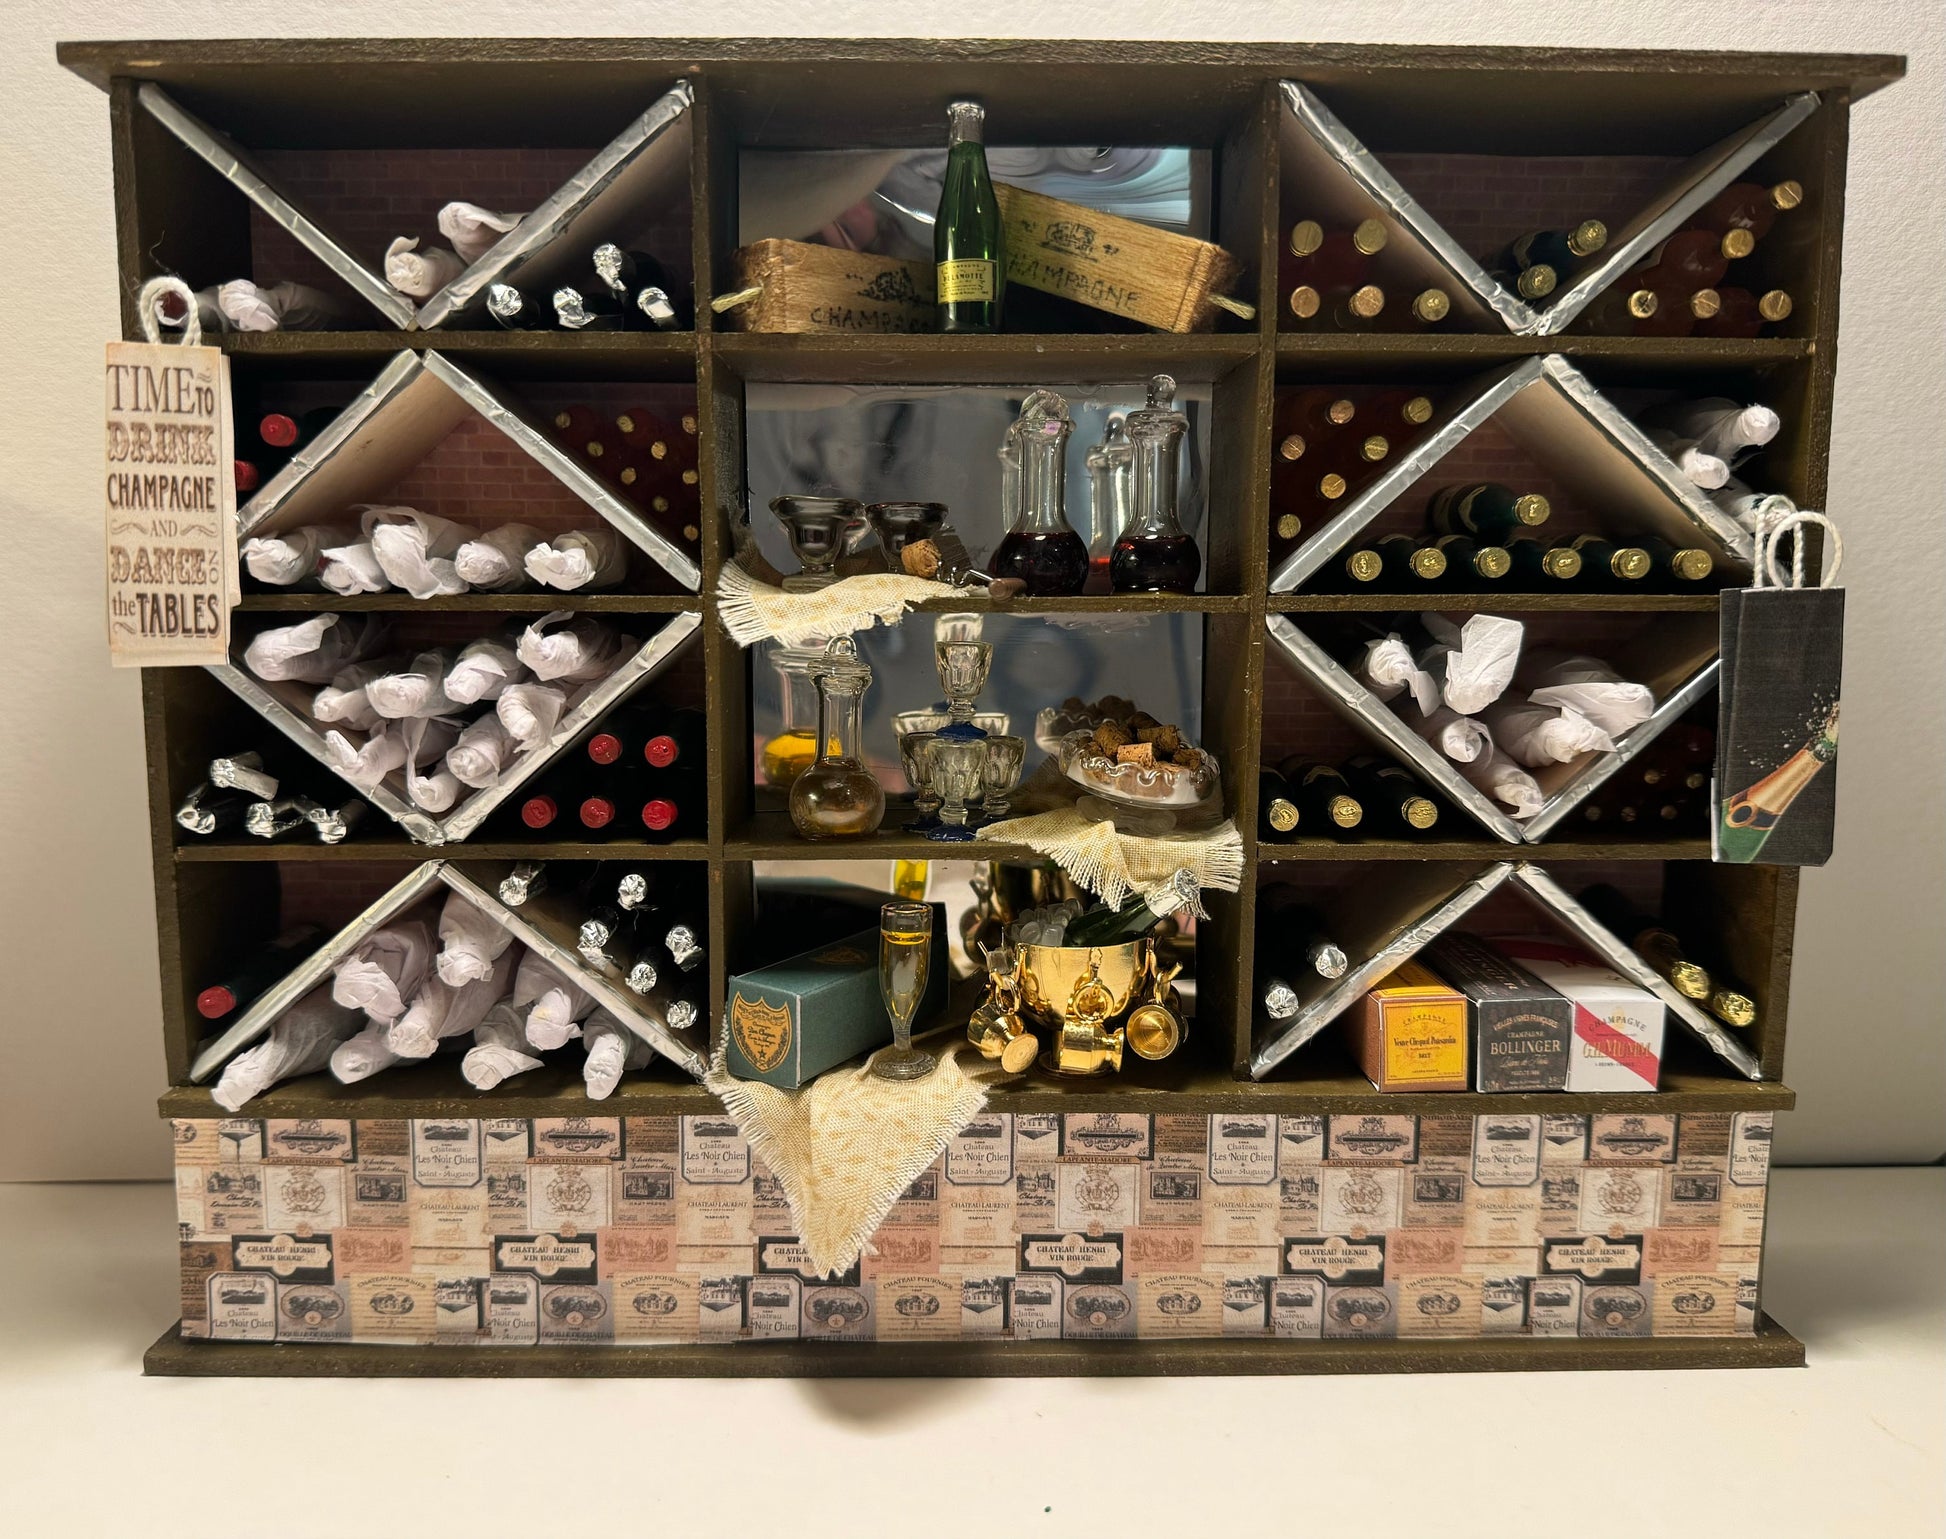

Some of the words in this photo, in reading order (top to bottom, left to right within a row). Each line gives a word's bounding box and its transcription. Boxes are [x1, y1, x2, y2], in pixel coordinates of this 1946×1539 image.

[107, 364, 196, 415] TIME
[195, 386, 214, 417] TO
[107, 420, 217, 466] DRINK
[107, 473, 216, 511] CHAMPAGNE
[150, 519, 178, 538] AND
[110, 545, 207, 586] DANCE
[112, 591, 136, 617] the
[136, 592, 220, 638] TABLES
[1588, 1015, 1648, 1032] CHAMPAGNE
[1507, 1030, 1545, 1038] CHAMPAGNE
[1490, 1039, 1561, 1055] BOLLINGER
[430, 1146, 461, 1154] Chateau
[963, 1143, 994, 1151] Chateau
[1226, 1143, 1258, 1151] Chateau
[1490, 1145, 1523, 1153] Chateau
[416, 1154, 431, 1163] Les
[432, 1153, 451, 1164] Noir
[453, 1154, 478, 1165] Chien
[685, 1152, 699, 1160] Les
[700, 1152, 721, 1161] Noir
[722, 1152, 746, 1162] Chien
[949, 1153, 964, 1161] Les
[965, 1152, 985, 1161] Noir
[986, 1152, 1009, 1163] Chien
[1212, 1152, 1228, 1161] Les
[1228, 1152, 1248, 1161] Noir
[1249, 1152, 1273, 1163] Chien
[1475, 1154, 1491, 1163] Les
[1492, 1153, 1512, 1163] Noir
[1512, 1154, 1536, 1165] Chien
[1733, 1154, 1748, 1163] Les
[1749, 1153, 1768, 1163] Noir
[247, 1246, 286, 1254] CHATEAU
[289, 1246, 317, 1254] HENRI
[510, 1246, 549, 1254] CHATEAU
[552, 1246, 580, 1254] HENRI
[774, 1247, 809, 1255] CHATEA
[1036, 1245, 1075, 1253] CHATEAU
[1079, 1246, 1107, 1254] HENRI
[1299, 1248, 1337, 1256] CHATEAU
[260, 1254, 276, 1262] VIN
[523, 1254, 539, 1262] VIN
[540, 1254, 568, 1262] ROUGE
[1066, 1254, 1094, 1262] ROUGE
[883, 1276, 916, 1290] CHATEAU
[917, 1276, 953, 1290] FOURNIER
[1144, 1275, 1178, 1288] CHATEAU
[1179, 1274, 1216, 1289] FOURNIER
[227, 1310, 259, 1318] Chateau
[213, 1319, 228, 1328] Les
[229, 1318, 249, 1328] Noir
[251, 1319, 274, 1329] Chien
[492, 1318, 511, 1328] Noir
[512, 1318, 536, 1329] Chien
[754, 1321, 773, 1331] Noir
[774, 1321, 797, 1332] Chien
[1016, 1319, 1035, 1328] Noir
[1035, 1319, 1059, 1329] Chien
[1277, 1320, 1296, 1330] Noir
[1296, 1320, 1320, 1330] Chien
[1535, 1320, 1553, 1329] Noir
[1553, 1319, 1576, 1330] Chien
